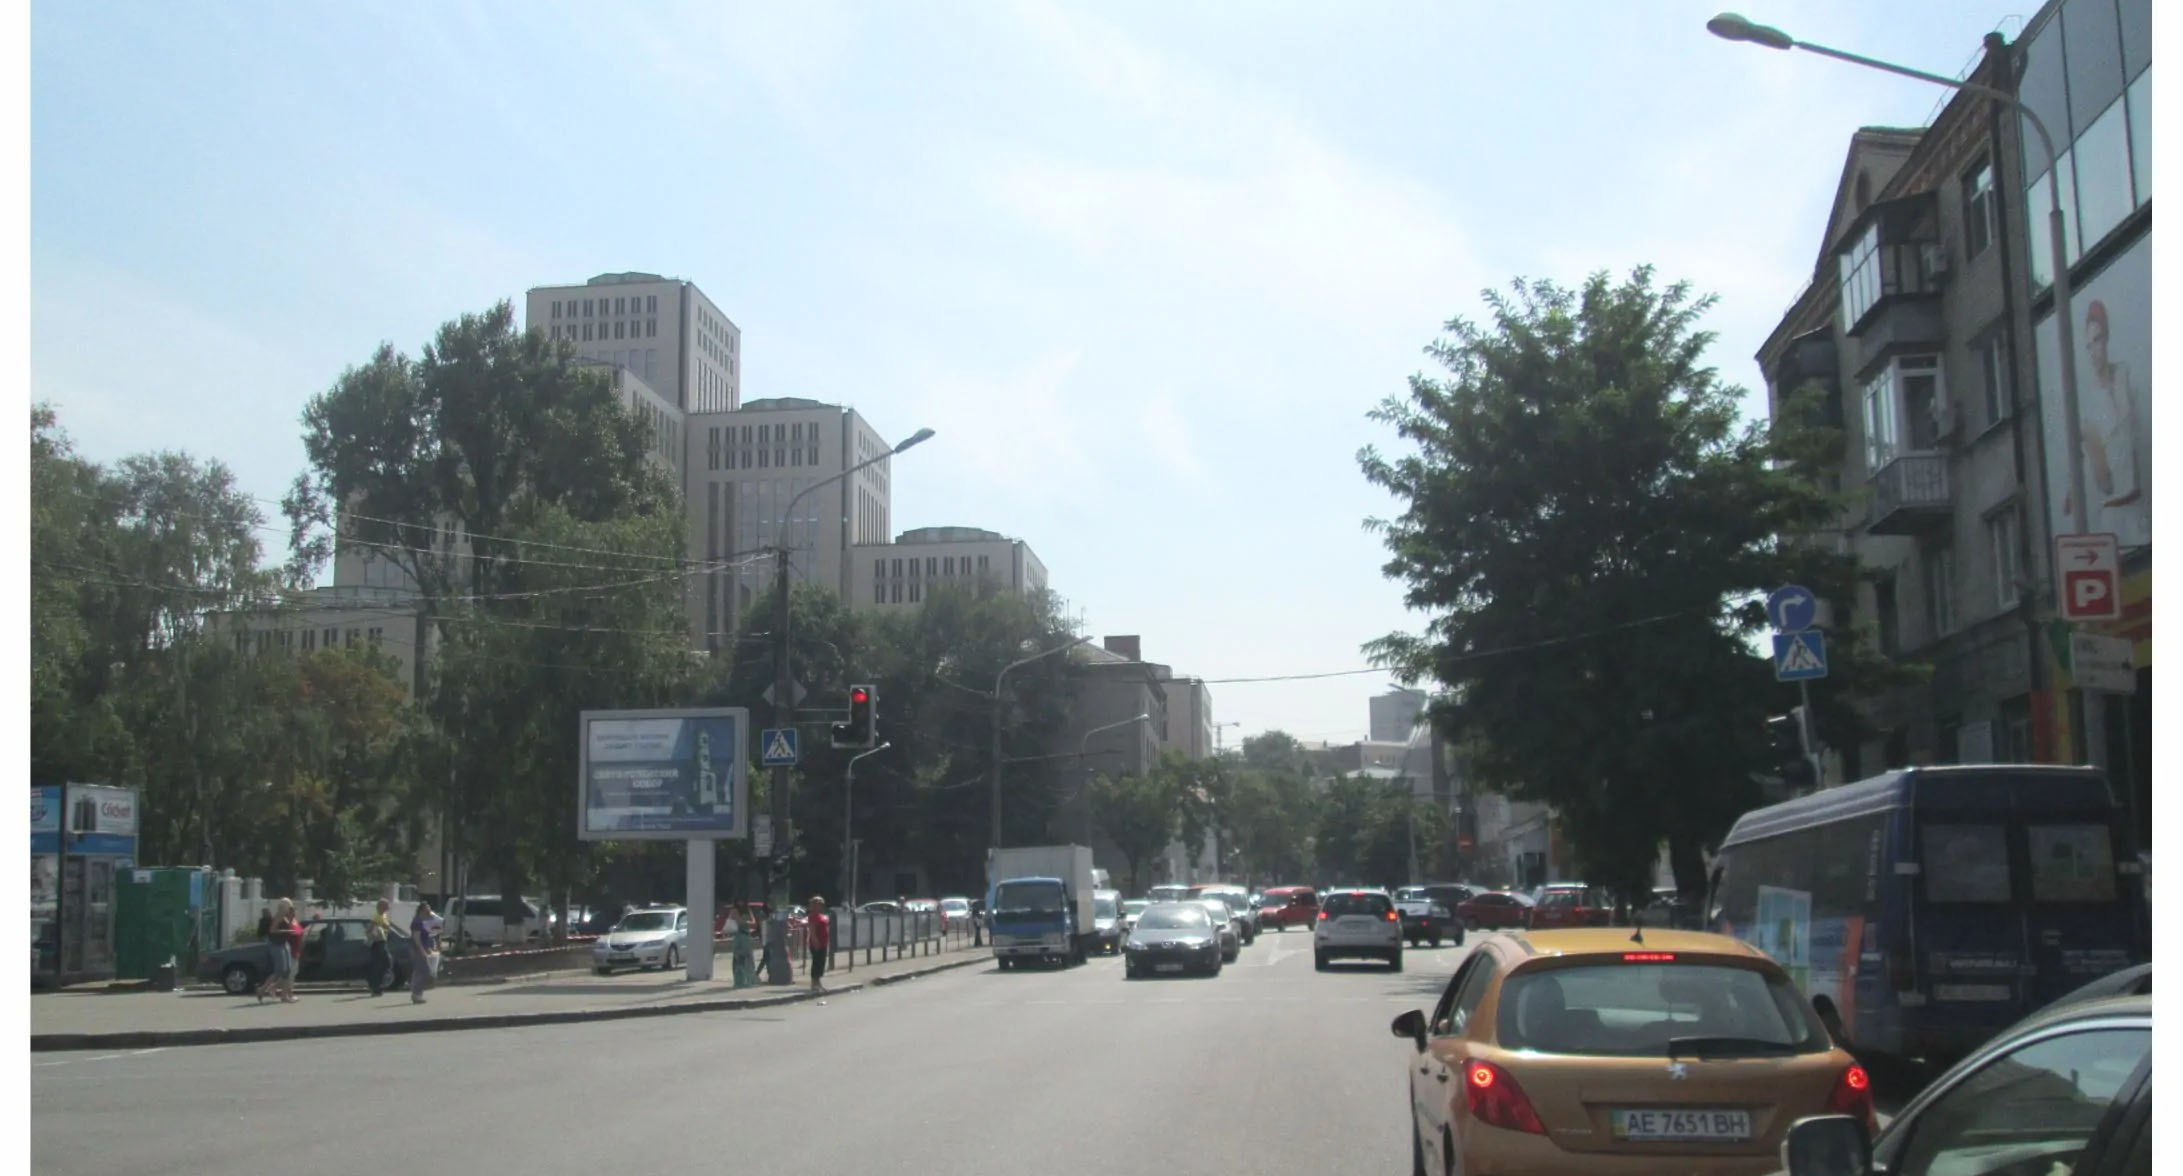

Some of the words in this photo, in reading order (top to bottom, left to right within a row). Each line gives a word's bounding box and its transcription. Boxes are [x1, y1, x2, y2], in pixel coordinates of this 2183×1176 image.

[2075, 578, 2107, 608] P
[1628, 1113, 1655, 1133] AE
[1662, 1114, 1711, 1133] 7651
[1714, 1114, 1745, 1134] BH
